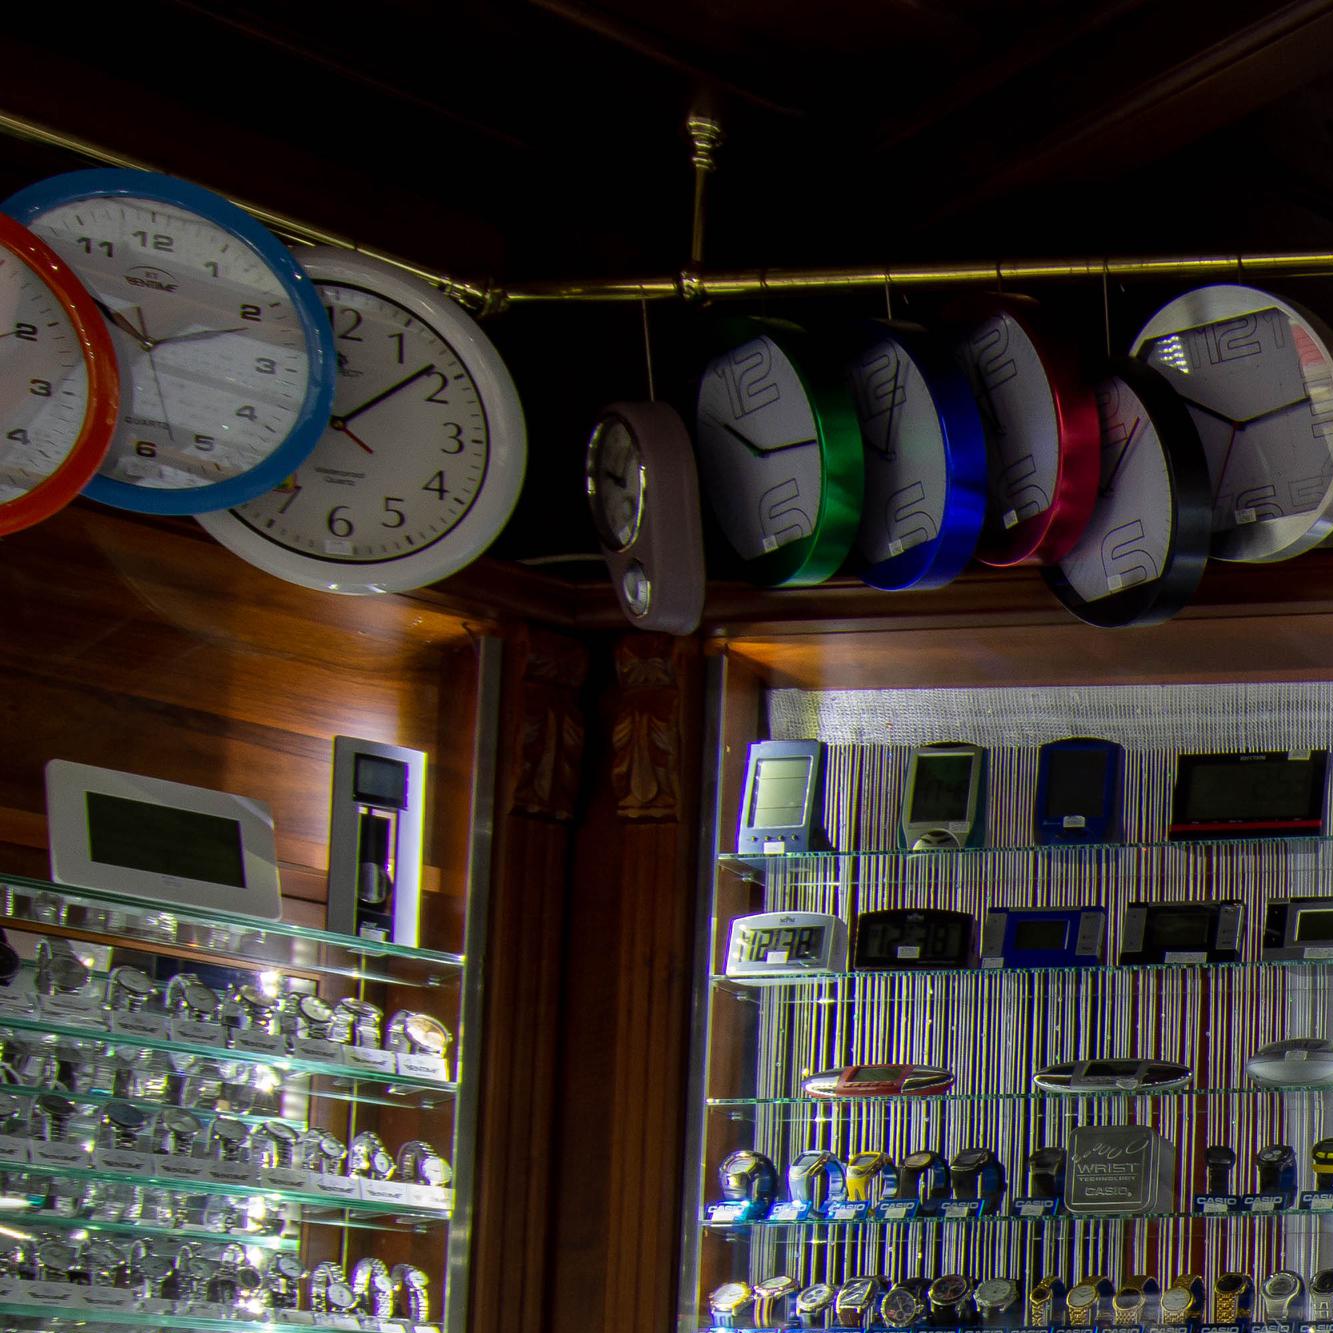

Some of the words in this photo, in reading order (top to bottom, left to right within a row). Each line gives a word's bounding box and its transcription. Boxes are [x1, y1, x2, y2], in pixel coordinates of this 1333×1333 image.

[77, 237, 114, 257] 11
[132, 231, 174, 252] 12
[204, 261, 219, 278] 1
[240, 304, 261, 322] 2
[15, 323, 38, 341] 2
[388, 333, 405, 364] 1
[255, 358, 276, 375] 3
[30, 379, 51, 397] 3
[425, 371, 449, 404] 2
[236, 405, 257, 421] 4
[7, 429, 30, 445] 4
[194, 435, 214, 451] 5
[441, 422, 465, 455] 3
[136, 441, 156, 458] 6
[422, 470, 449, 500] 4
[328, 505, 354, 537] 6
[382, 497, 406, 528] 5
[1078, 1163, 1137, 1174] WRIST
[1085, 1187, 1129, 1197] CASIO
[1244, 1196, 1282, 1204] CASIO
[880, 1202, 915, 1211] CASIO
[941, 1202, 978, 1210] CASIO
[1197, 1197, 1237, 1206] CASIO
